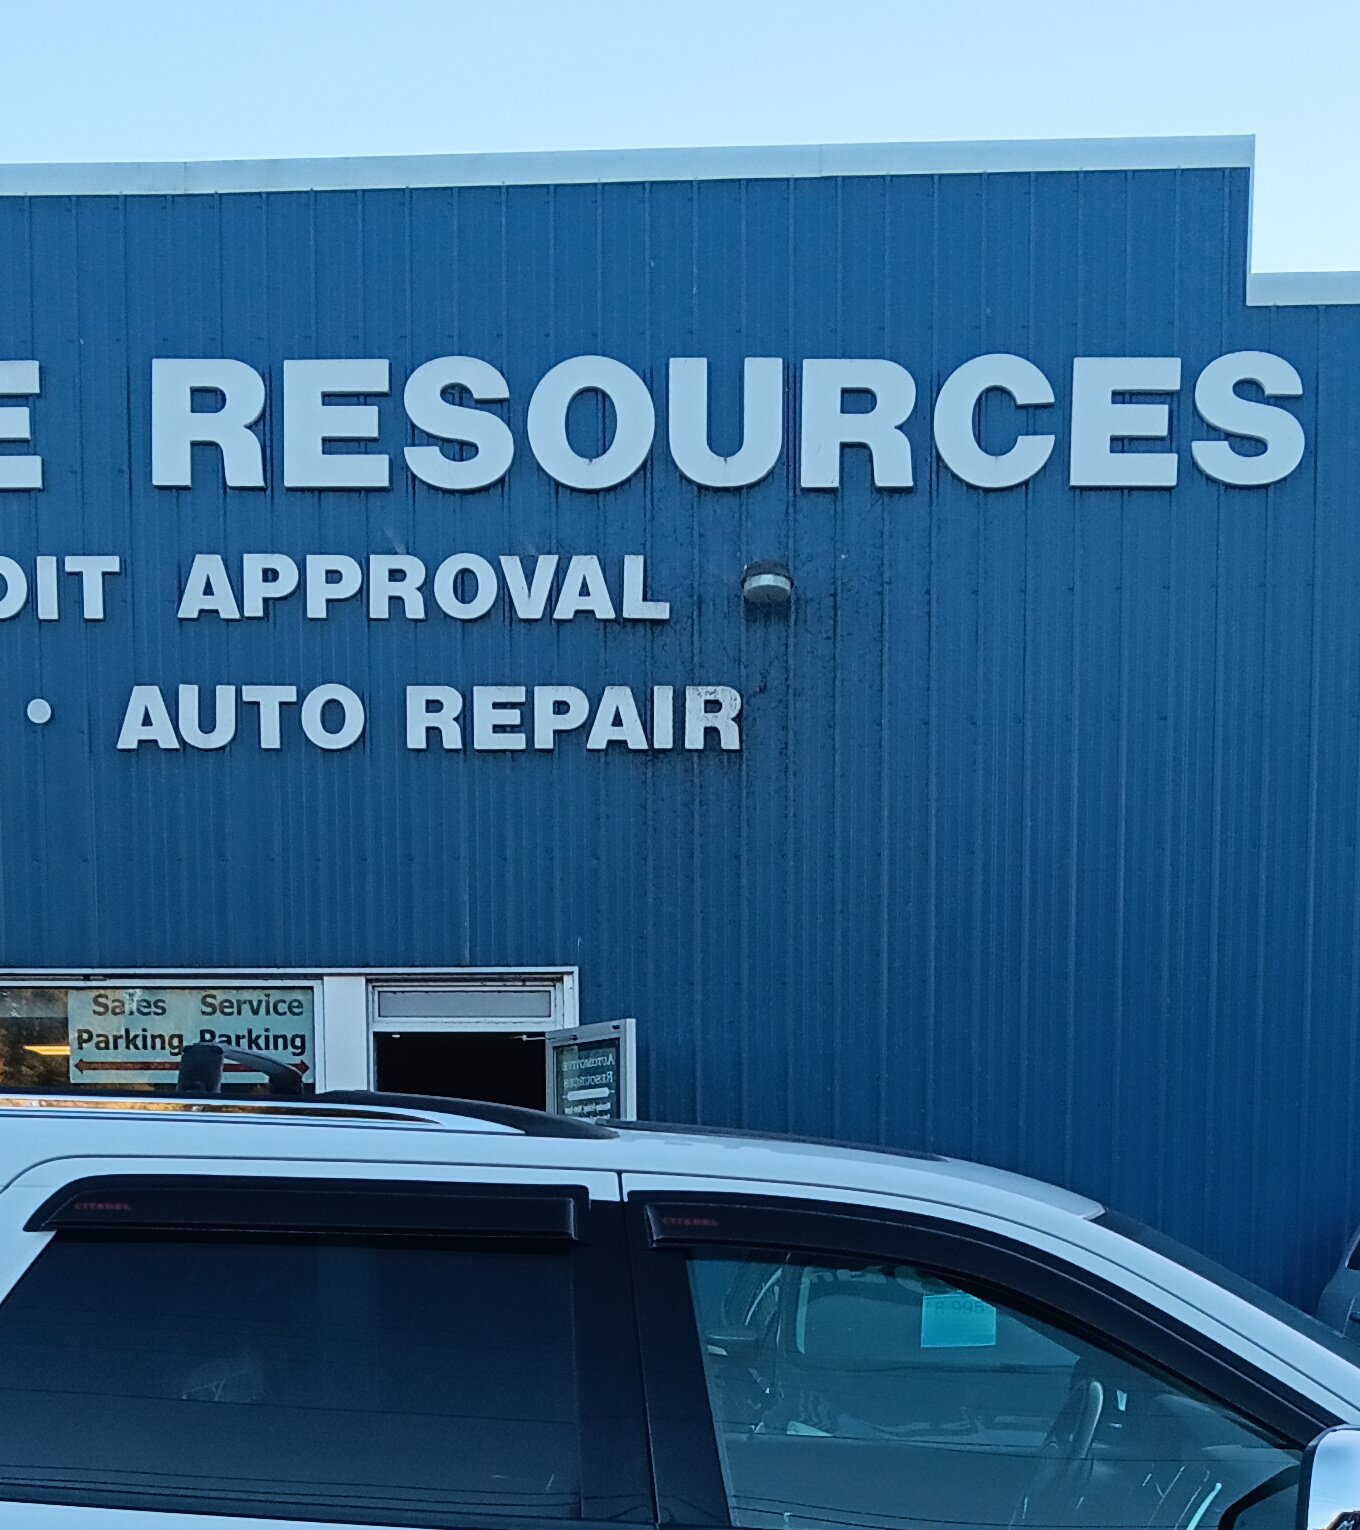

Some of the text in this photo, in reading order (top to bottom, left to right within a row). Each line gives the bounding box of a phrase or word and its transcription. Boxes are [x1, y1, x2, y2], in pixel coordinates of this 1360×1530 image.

[150, 350, 1307, 491] RESOURCES
[177, 552, 671, 621] APPROVAL
[116, 683, 366, 751] AUTO
[405, 684, 743, 751] REPAIR
[92, 992, 167, 1016] Sales
[200, 992, 304, 1016] Service
[77, 1027, 184, 1056] Parking
